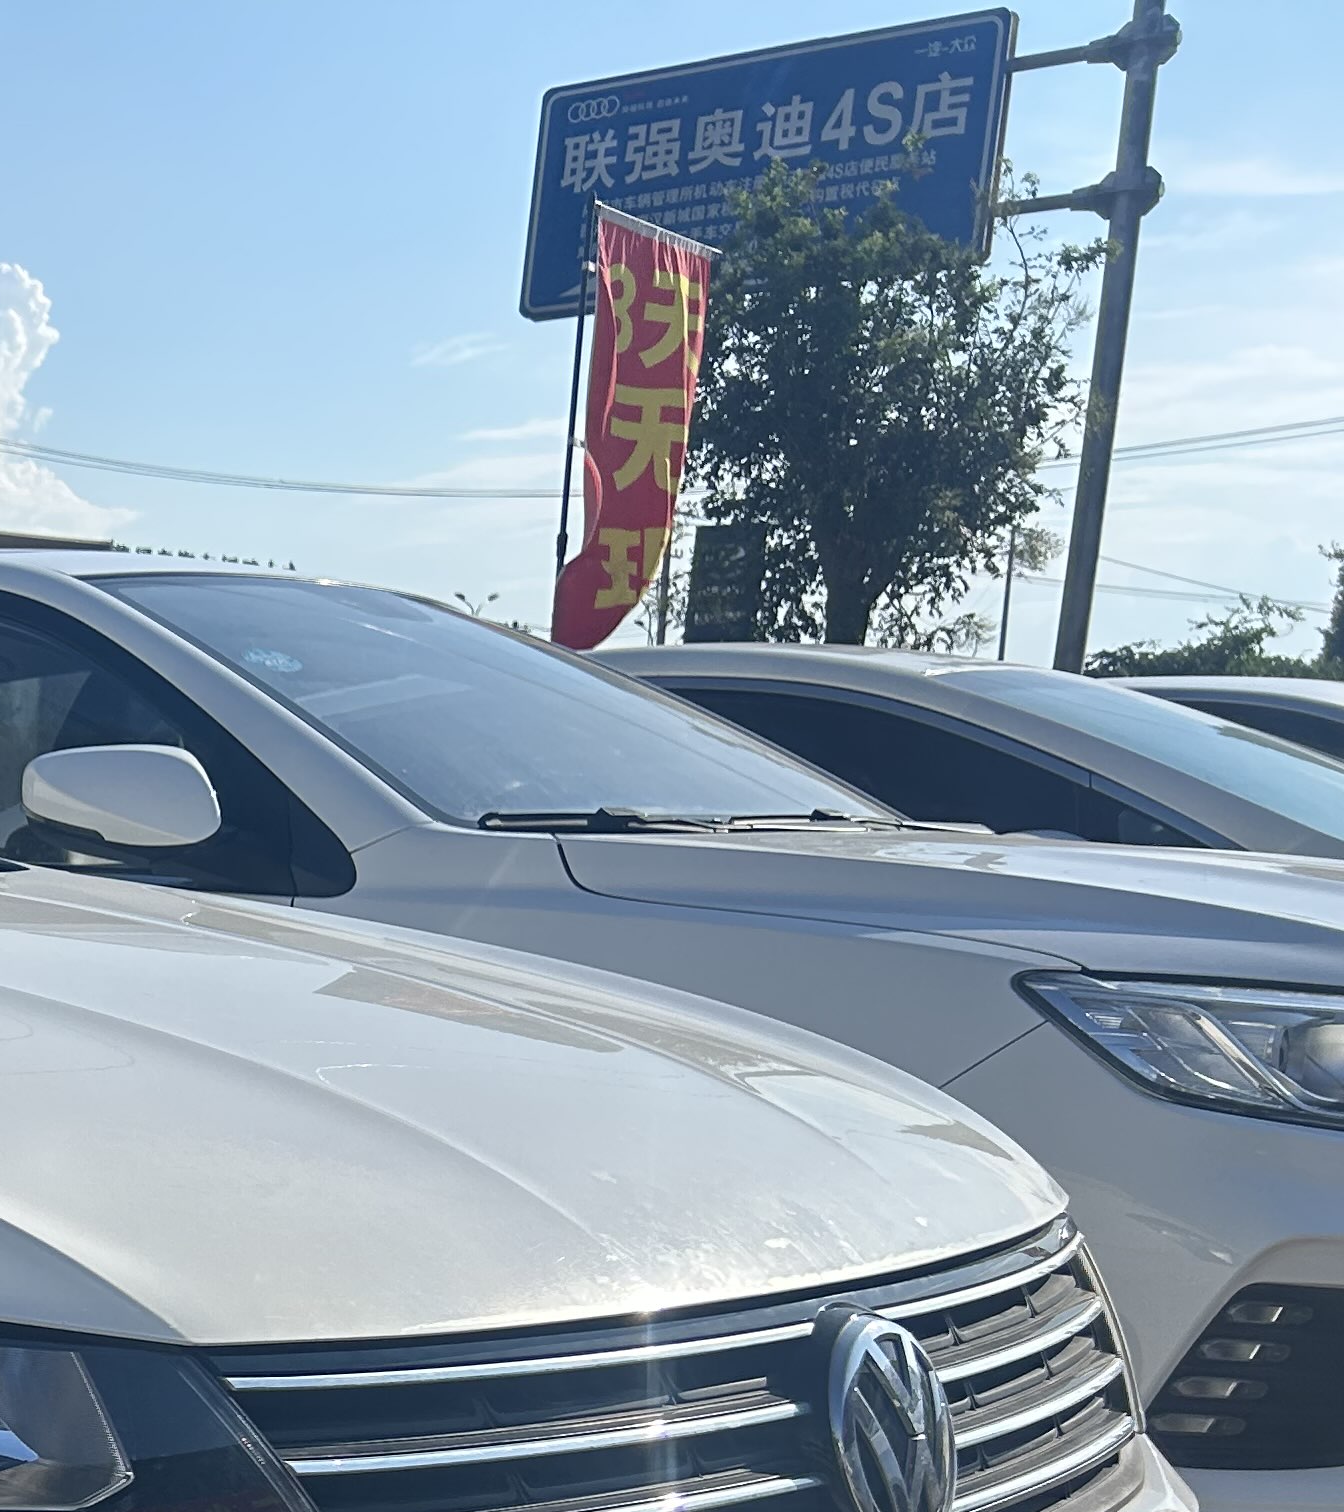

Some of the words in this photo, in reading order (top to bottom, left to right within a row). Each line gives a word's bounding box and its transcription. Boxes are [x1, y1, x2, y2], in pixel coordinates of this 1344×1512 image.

[561, 70, 974, 194] 联强奥迪4S店
